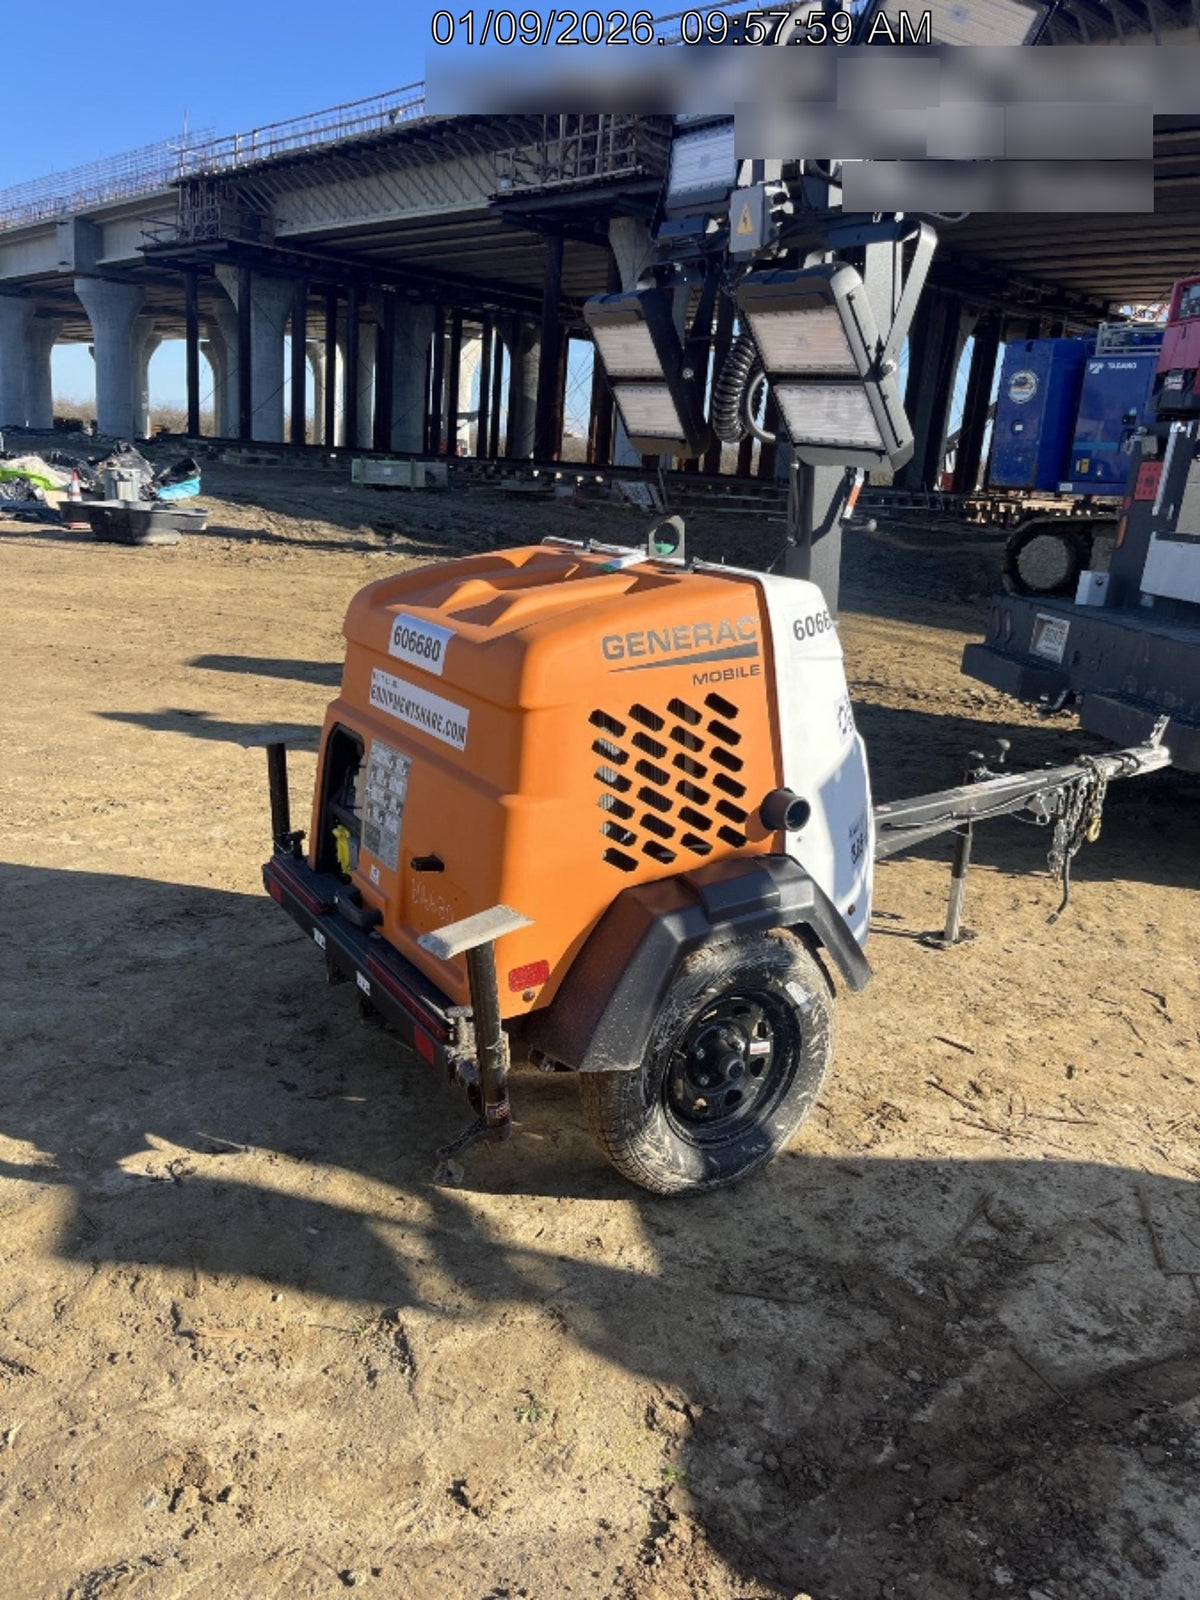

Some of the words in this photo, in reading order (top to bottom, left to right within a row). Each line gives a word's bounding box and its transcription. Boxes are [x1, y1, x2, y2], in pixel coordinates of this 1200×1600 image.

[394, 625, 442, 662] 606680
[601, 615, 757, 661] GENERAC
[692, 664, 761, 687] MOBILE
